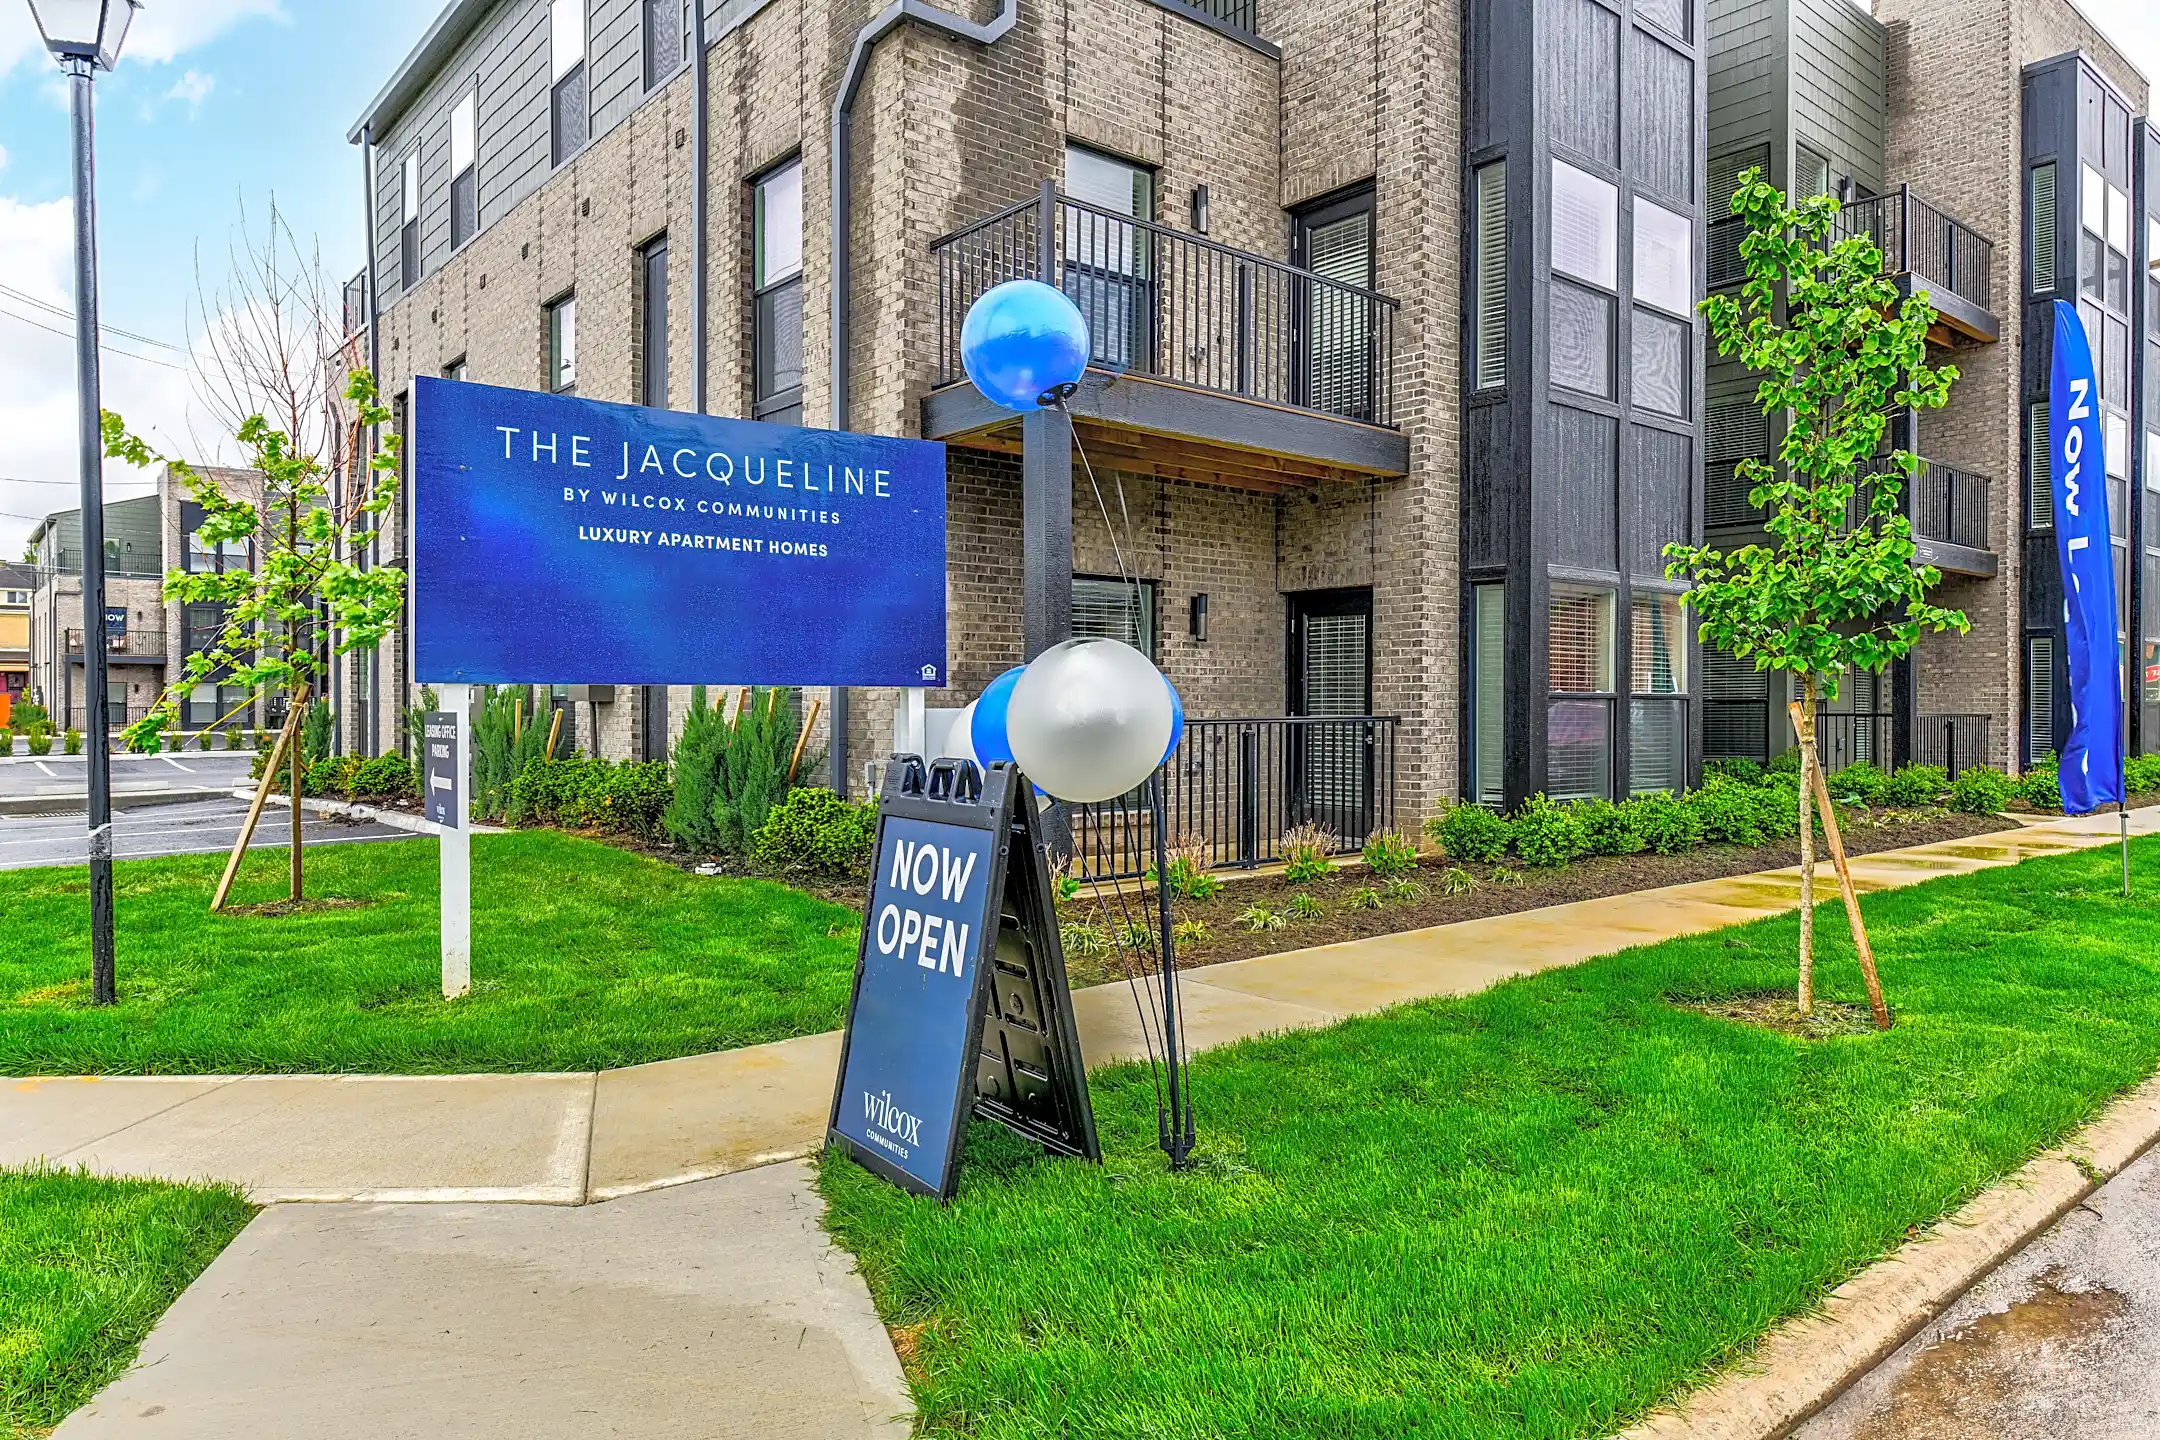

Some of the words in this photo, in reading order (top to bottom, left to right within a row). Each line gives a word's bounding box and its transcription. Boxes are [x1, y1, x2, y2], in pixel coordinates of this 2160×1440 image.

[496, 425, 592, 468] THE
[616, 441, 891, 498] JACQUELINE
[2064, 378, 2090, 517] NOW
[563, 487, 590, 503] BY
[602, 490, 686, 513] WILCOX
[696, 500, 841, 525] COMMUNITIES
[578, 525, 653, 548] LUXURY
[657, 532, 764, 554] APARTMENT
[769, 540, 829, 557] HOMES
[424, 724, 441, 739] LEASING
[441, 725, 456, 740] OFFICE
[431, 743, 450, 759] PARKING
[889, 838, 978, 905] NOW
[877, 903, 970, 979] OPEN
[863, 1089, 923, 1148] wilcox
[866, 1128, 909, 1160] COMMUNITIES
